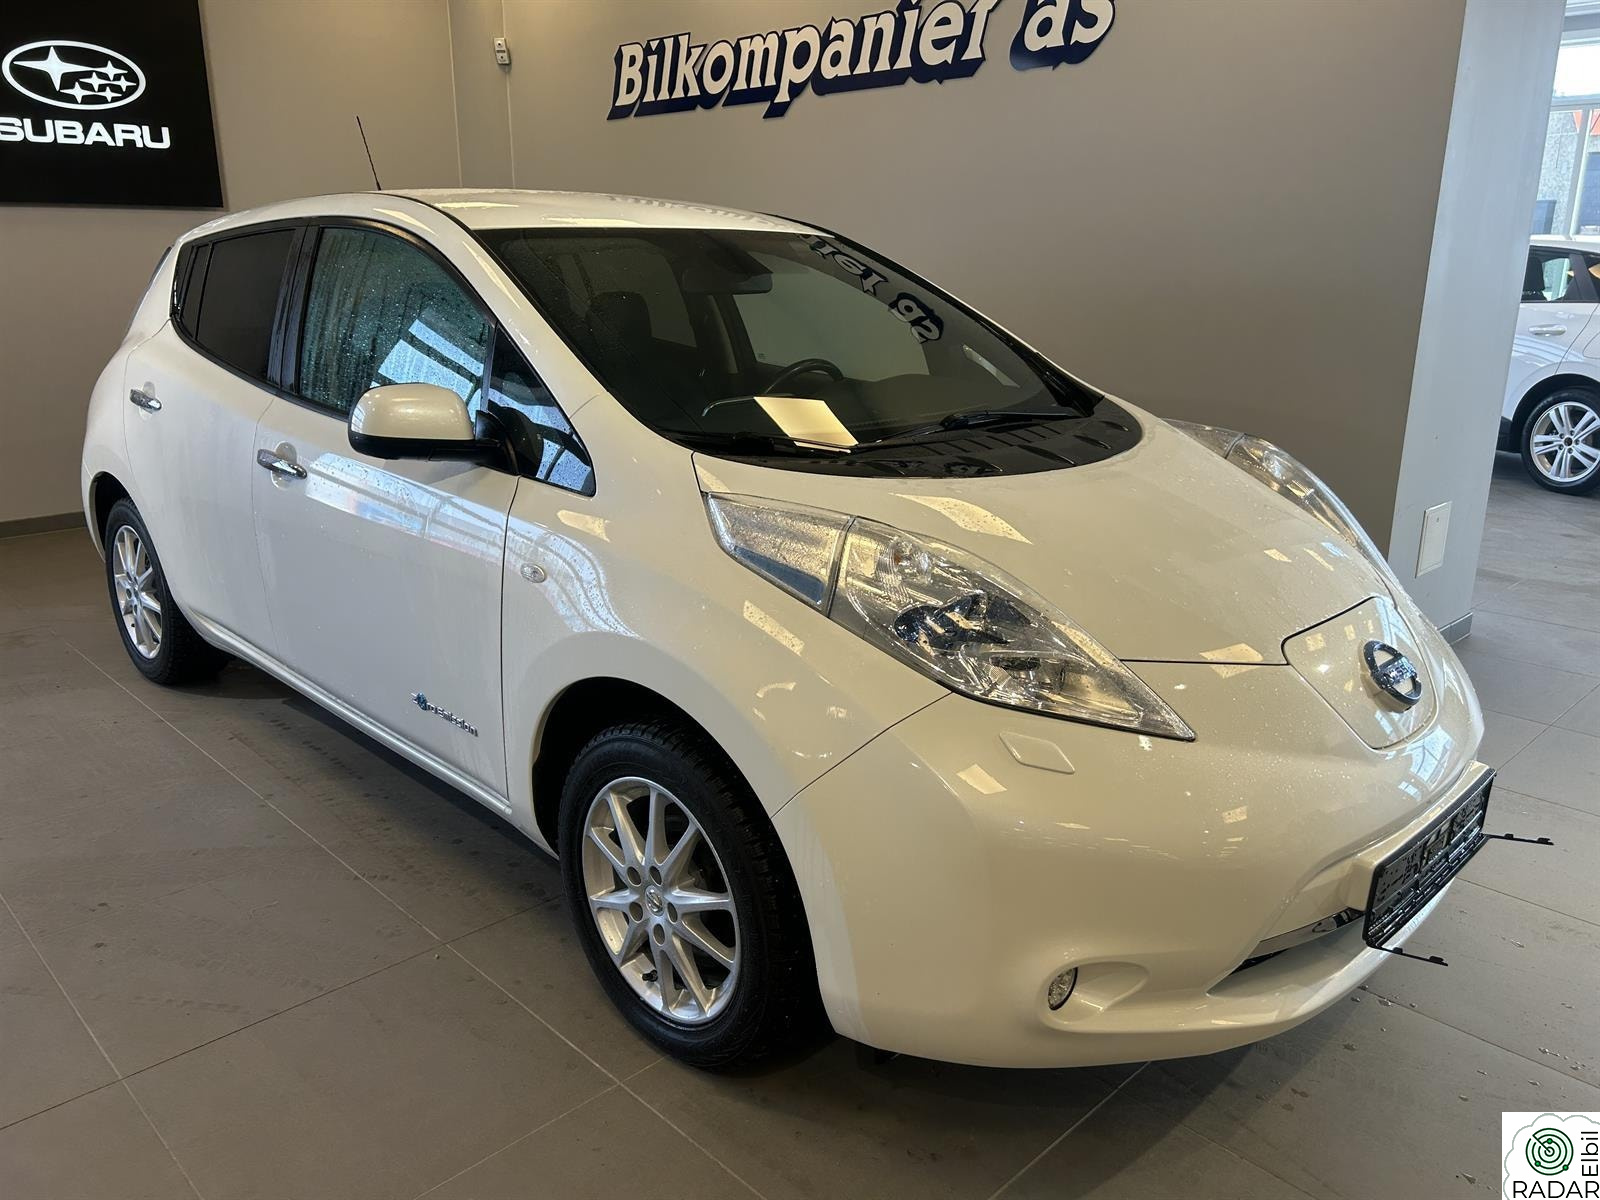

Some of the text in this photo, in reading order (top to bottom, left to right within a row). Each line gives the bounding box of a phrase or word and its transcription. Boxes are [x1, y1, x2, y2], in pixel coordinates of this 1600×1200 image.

[604, 0, 1115, 114] Bilkompaniet as
[0, 116, 171, 149] SUBARU
